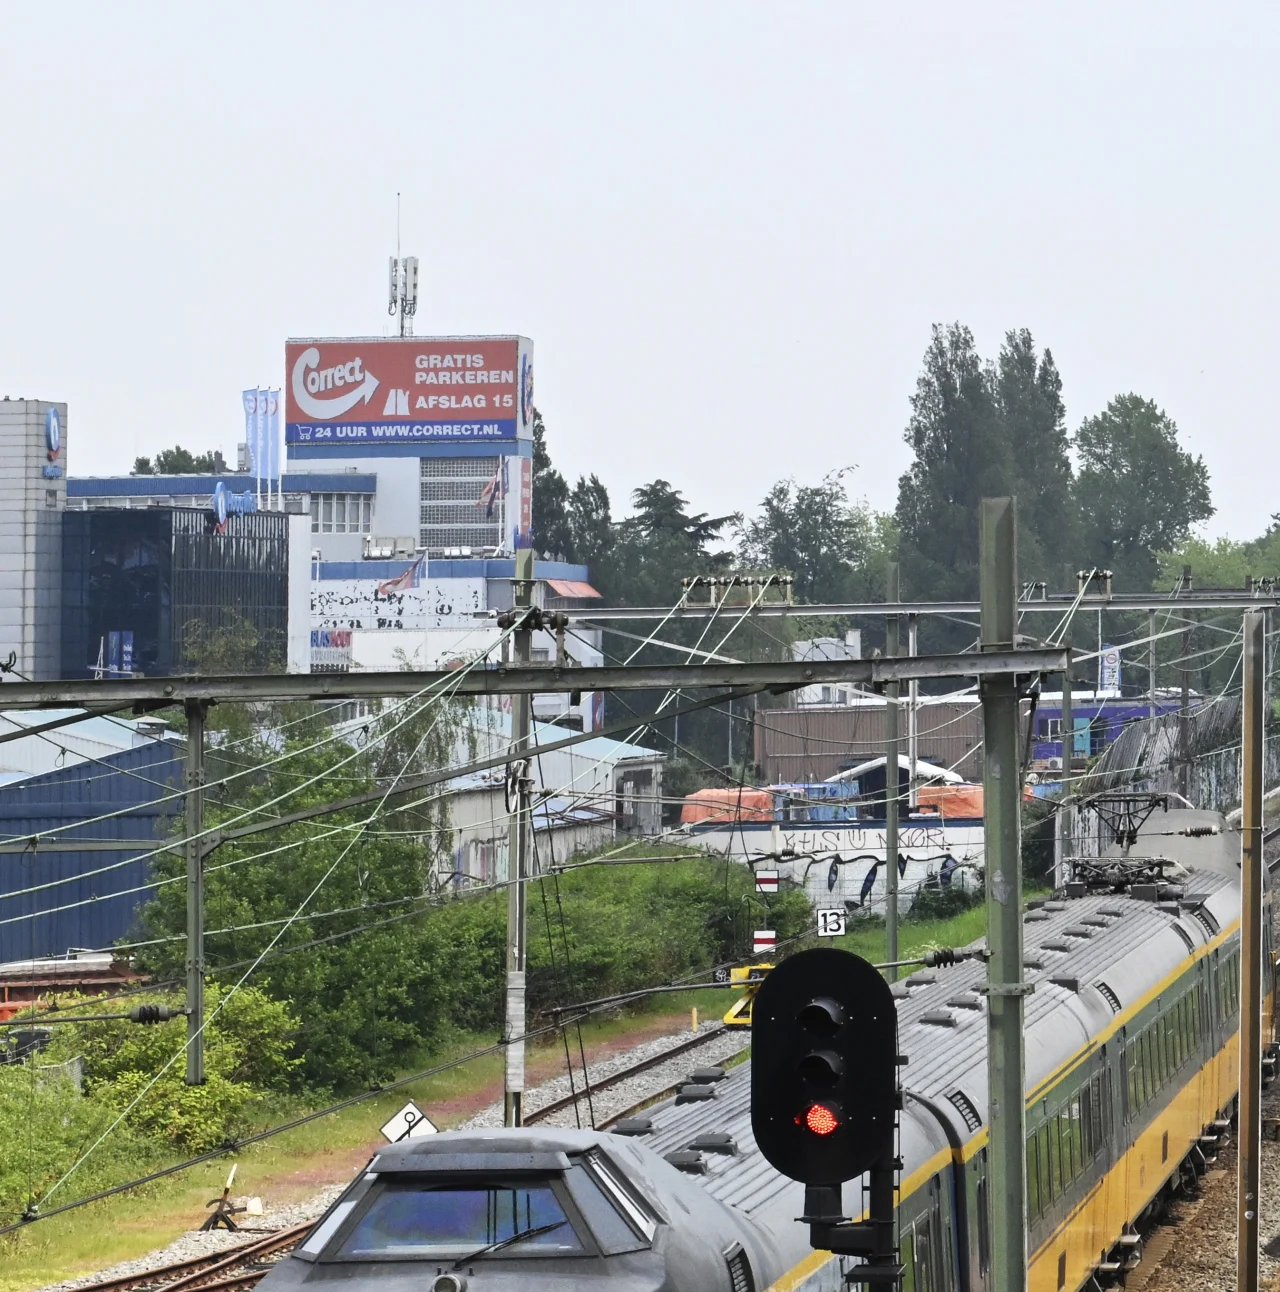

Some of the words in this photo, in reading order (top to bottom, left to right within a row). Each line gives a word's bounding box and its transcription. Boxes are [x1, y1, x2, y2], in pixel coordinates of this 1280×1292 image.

[415, 354, 485, 369] GRATIS
[292, 347, 380, 420] Correct
[415, 370, 514, 384] PARKEREN
[415, 395, 486, 409] AFSLAG
[493, 394, 514, 408] 15
[315, 425, 332, 438] 24
[336, 425, 367, 438] UUR
[371, 423, 503, 437] WWW.CORRECT.NL
[820, 912, 842, 933] 13
